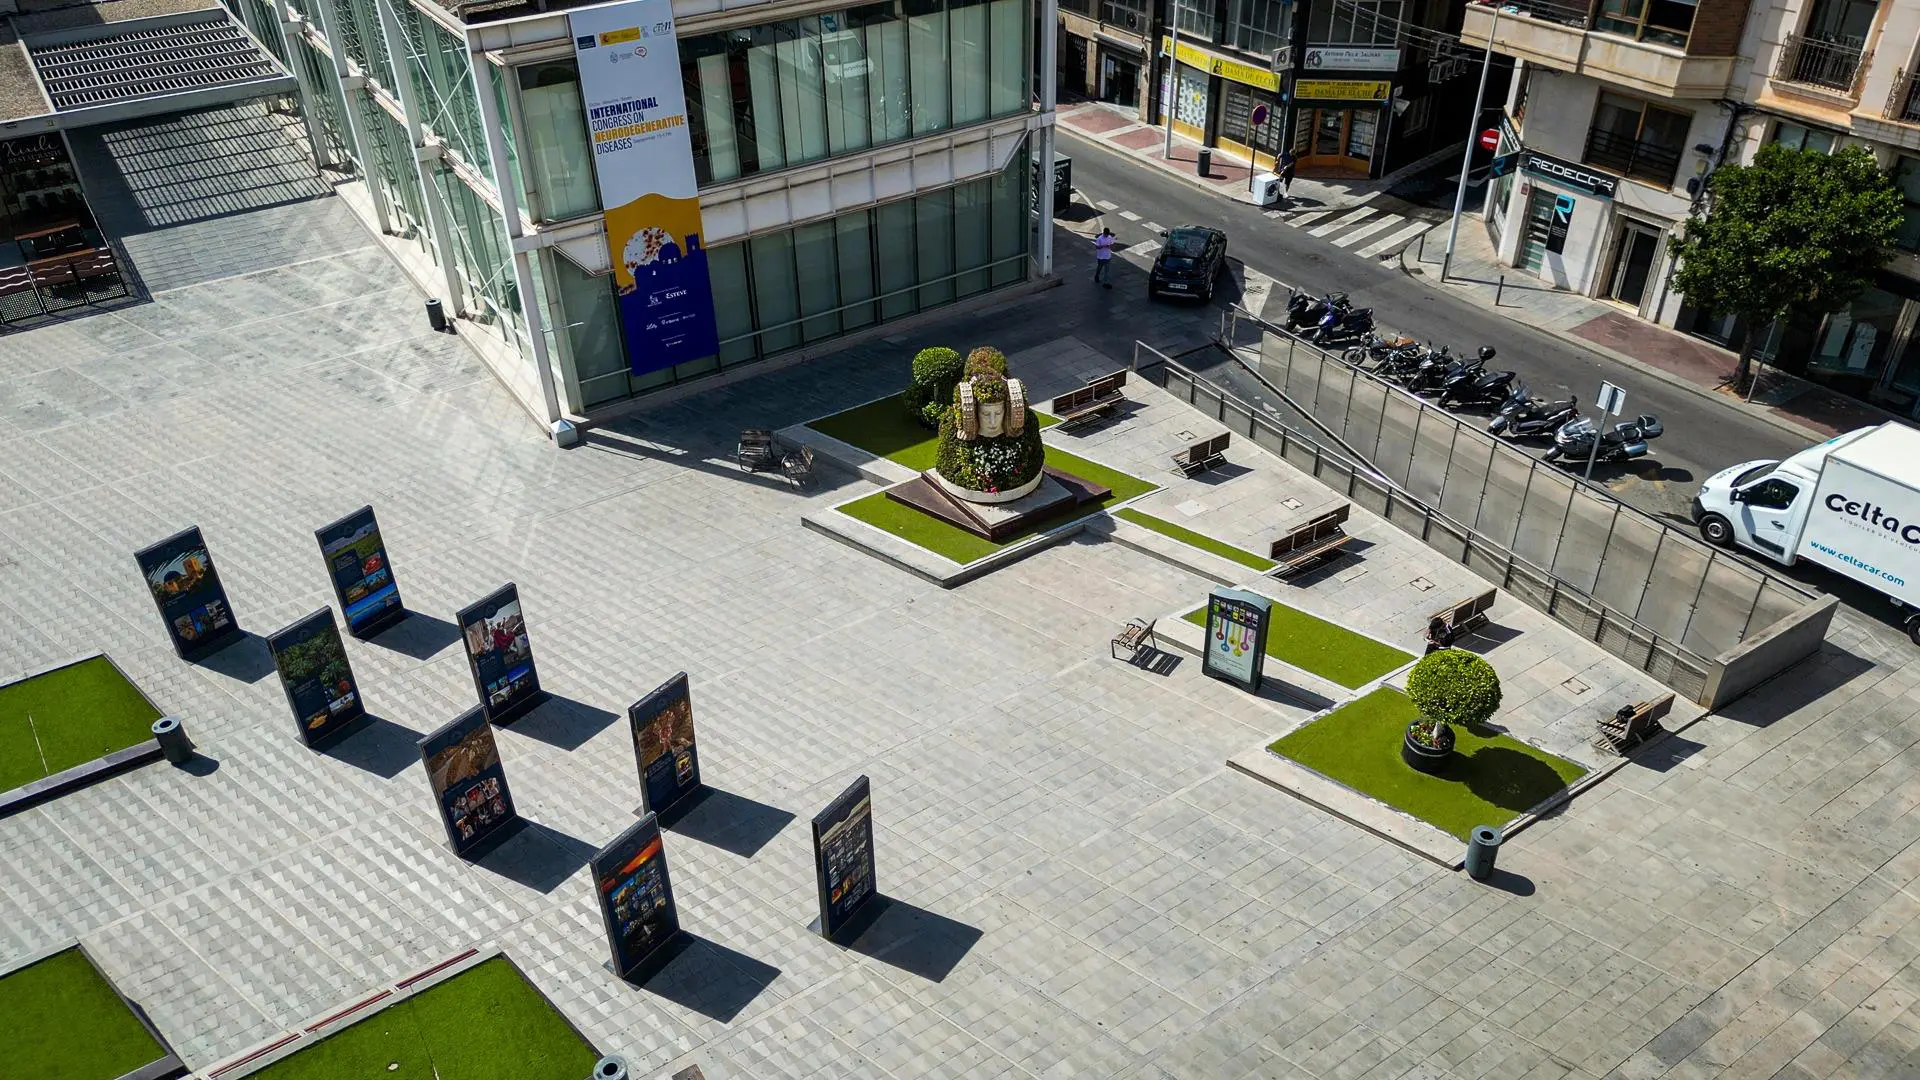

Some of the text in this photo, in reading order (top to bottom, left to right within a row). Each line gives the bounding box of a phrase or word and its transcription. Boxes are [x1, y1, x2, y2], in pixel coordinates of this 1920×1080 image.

[590, 97, 658, 120] INTERNATIONAL
[592, 111, 645, 132] CONGRESS ON
[594, 115, 685, 143] NEURODEGENERATIVE
[596, 138, 632, 155] DISEASES
[1529, 157, 1614, 192] REDECOR
[1810, 540, 1905, 587] www.celtacar.com
